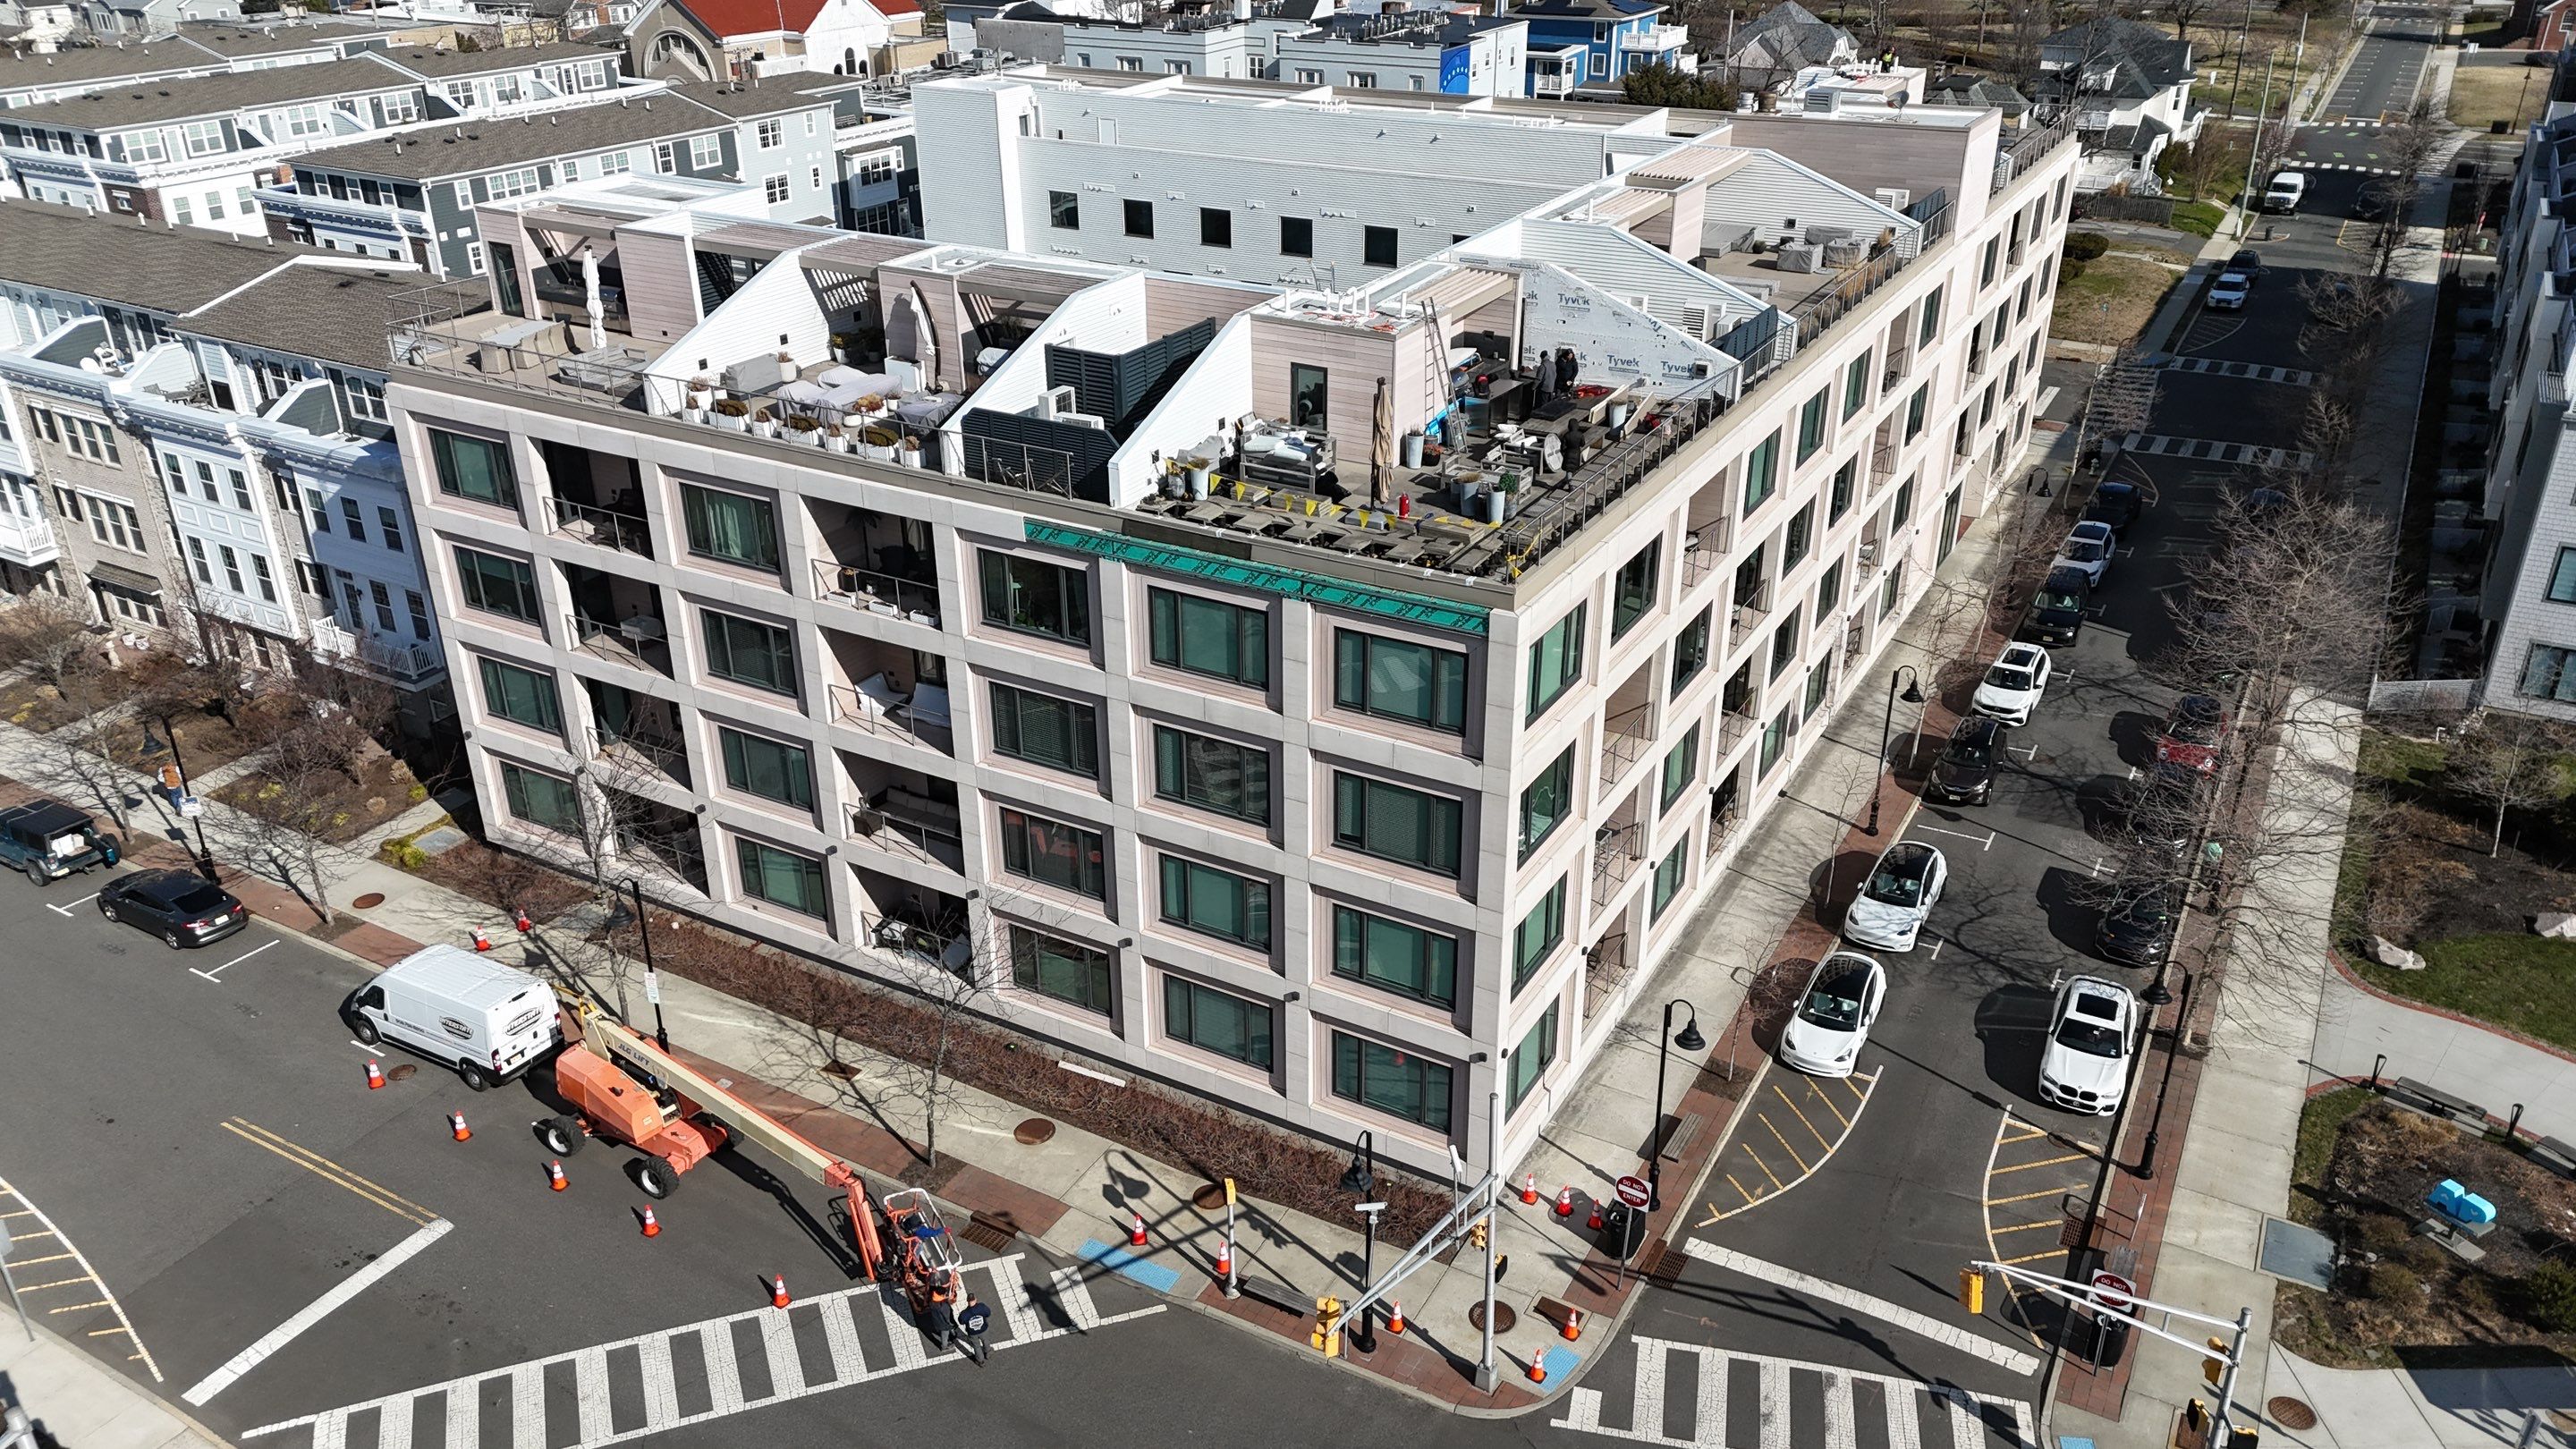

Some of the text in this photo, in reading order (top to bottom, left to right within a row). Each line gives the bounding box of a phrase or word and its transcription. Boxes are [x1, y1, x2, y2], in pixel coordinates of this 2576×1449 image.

[1607, 354, 1640, 368] Tyvek
[1661, 360, 1693, 373] Tyvek
[618, 1043, 649, 1066] JLG LIFT
[1632, 1183, 1644, 1191] NOT
[1623, 1193, 1641, 1204] ENTER
[2113, 1282, 2127, 1290] NOT
